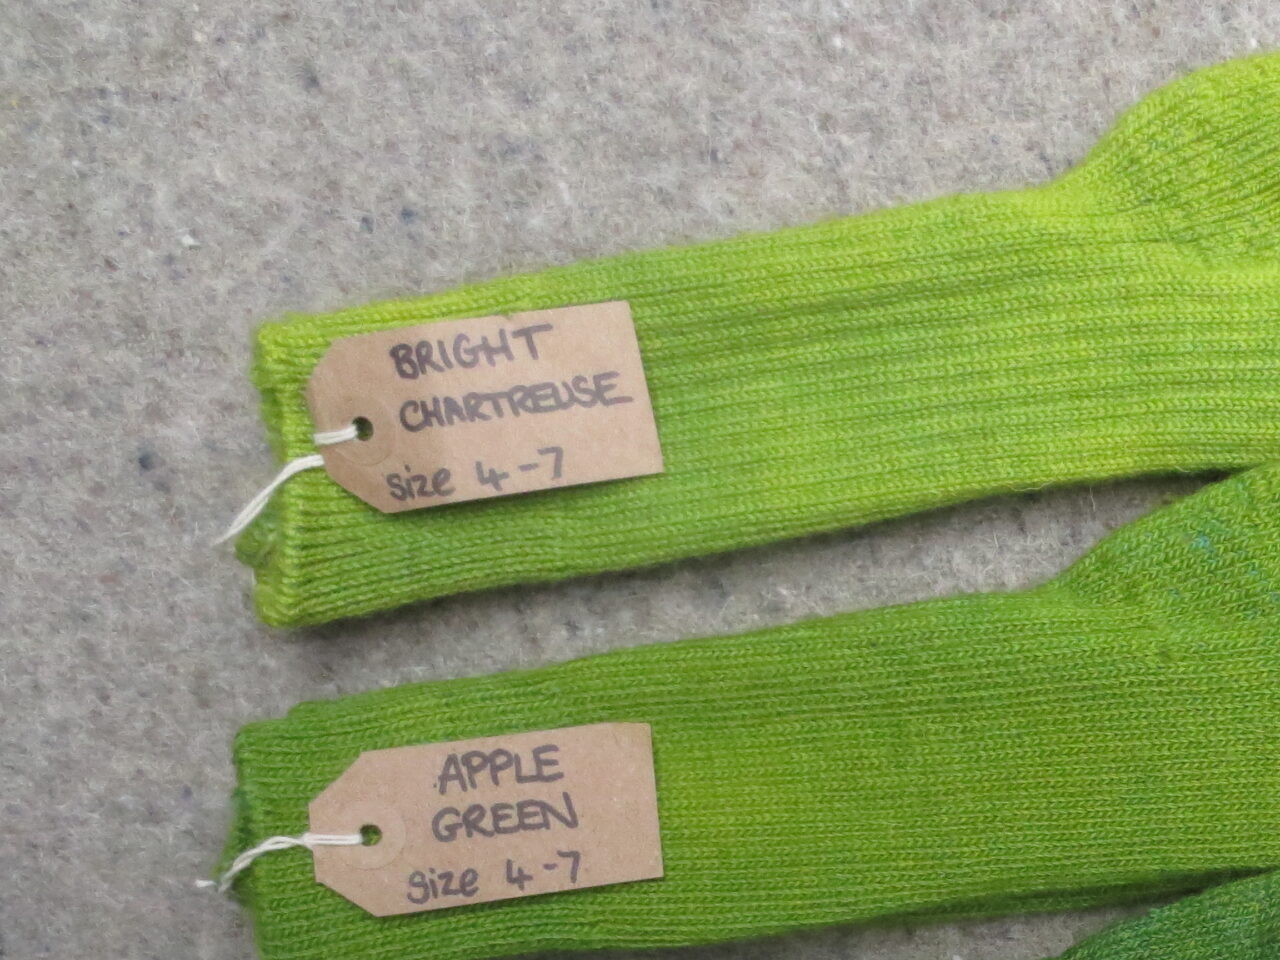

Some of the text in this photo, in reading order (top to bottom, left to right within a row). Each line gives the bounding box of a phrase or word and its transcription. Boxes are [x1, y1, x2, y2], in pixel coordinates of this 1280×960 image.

[389, 324, 553, 379] BRIGHT
[399, 371, 634, 432] CHARTREUSE
[386, 464, 456, 501] size
[438, 744, 564, 795] APPLE
[431, 792, 579, 842] GREEN
[406, 868, 480, 905] size
